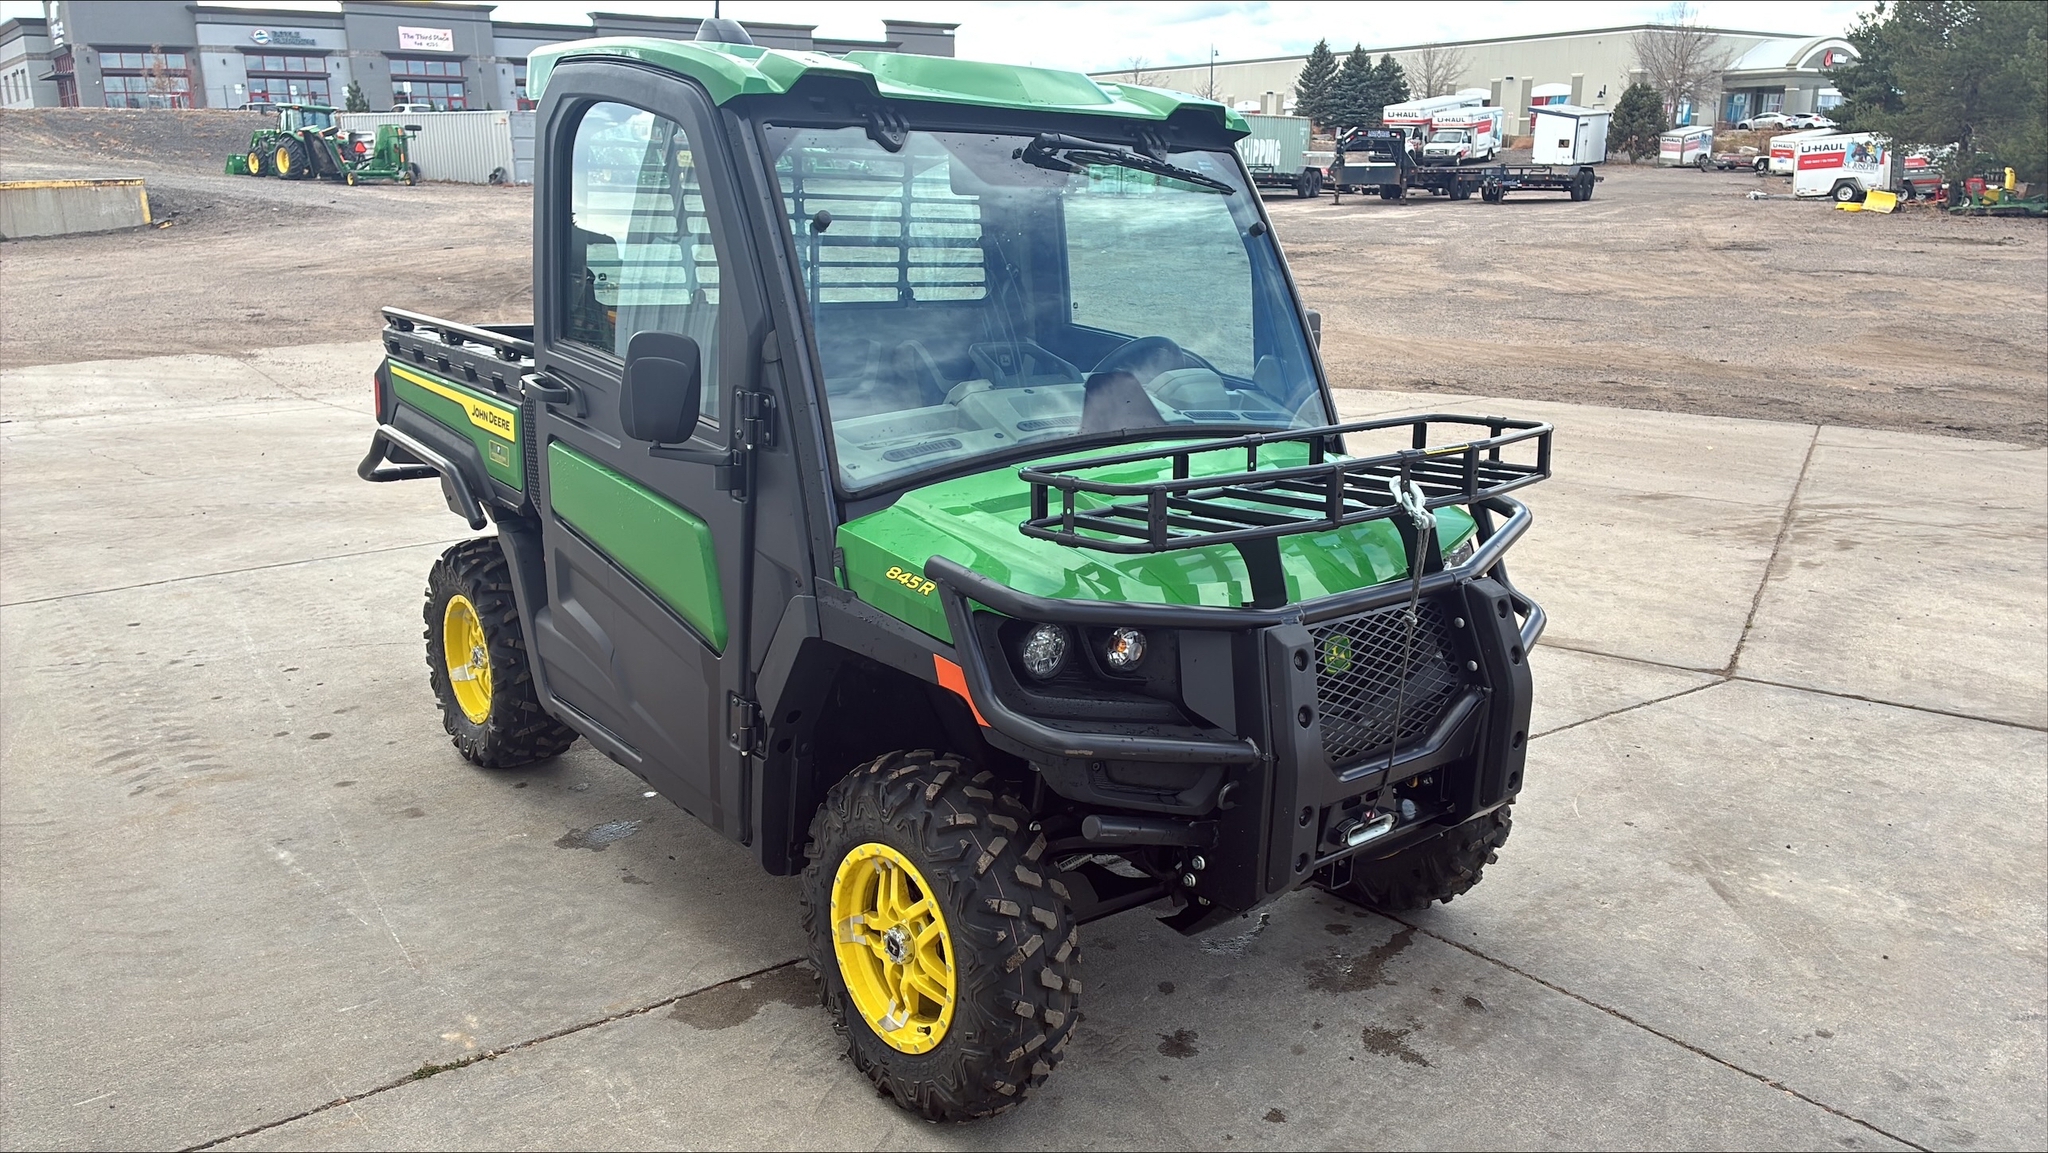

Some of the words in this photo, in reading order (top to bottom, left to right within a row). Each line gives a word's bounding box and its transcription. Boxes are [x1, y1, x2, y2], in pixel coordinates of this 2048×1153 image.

[415, 33, 432, 41] Third
[1801, 143, 1845, 153] U-HAUL
[471, 404, 489, 422] JOHN
[489, 411, 510, 431] DEERE
